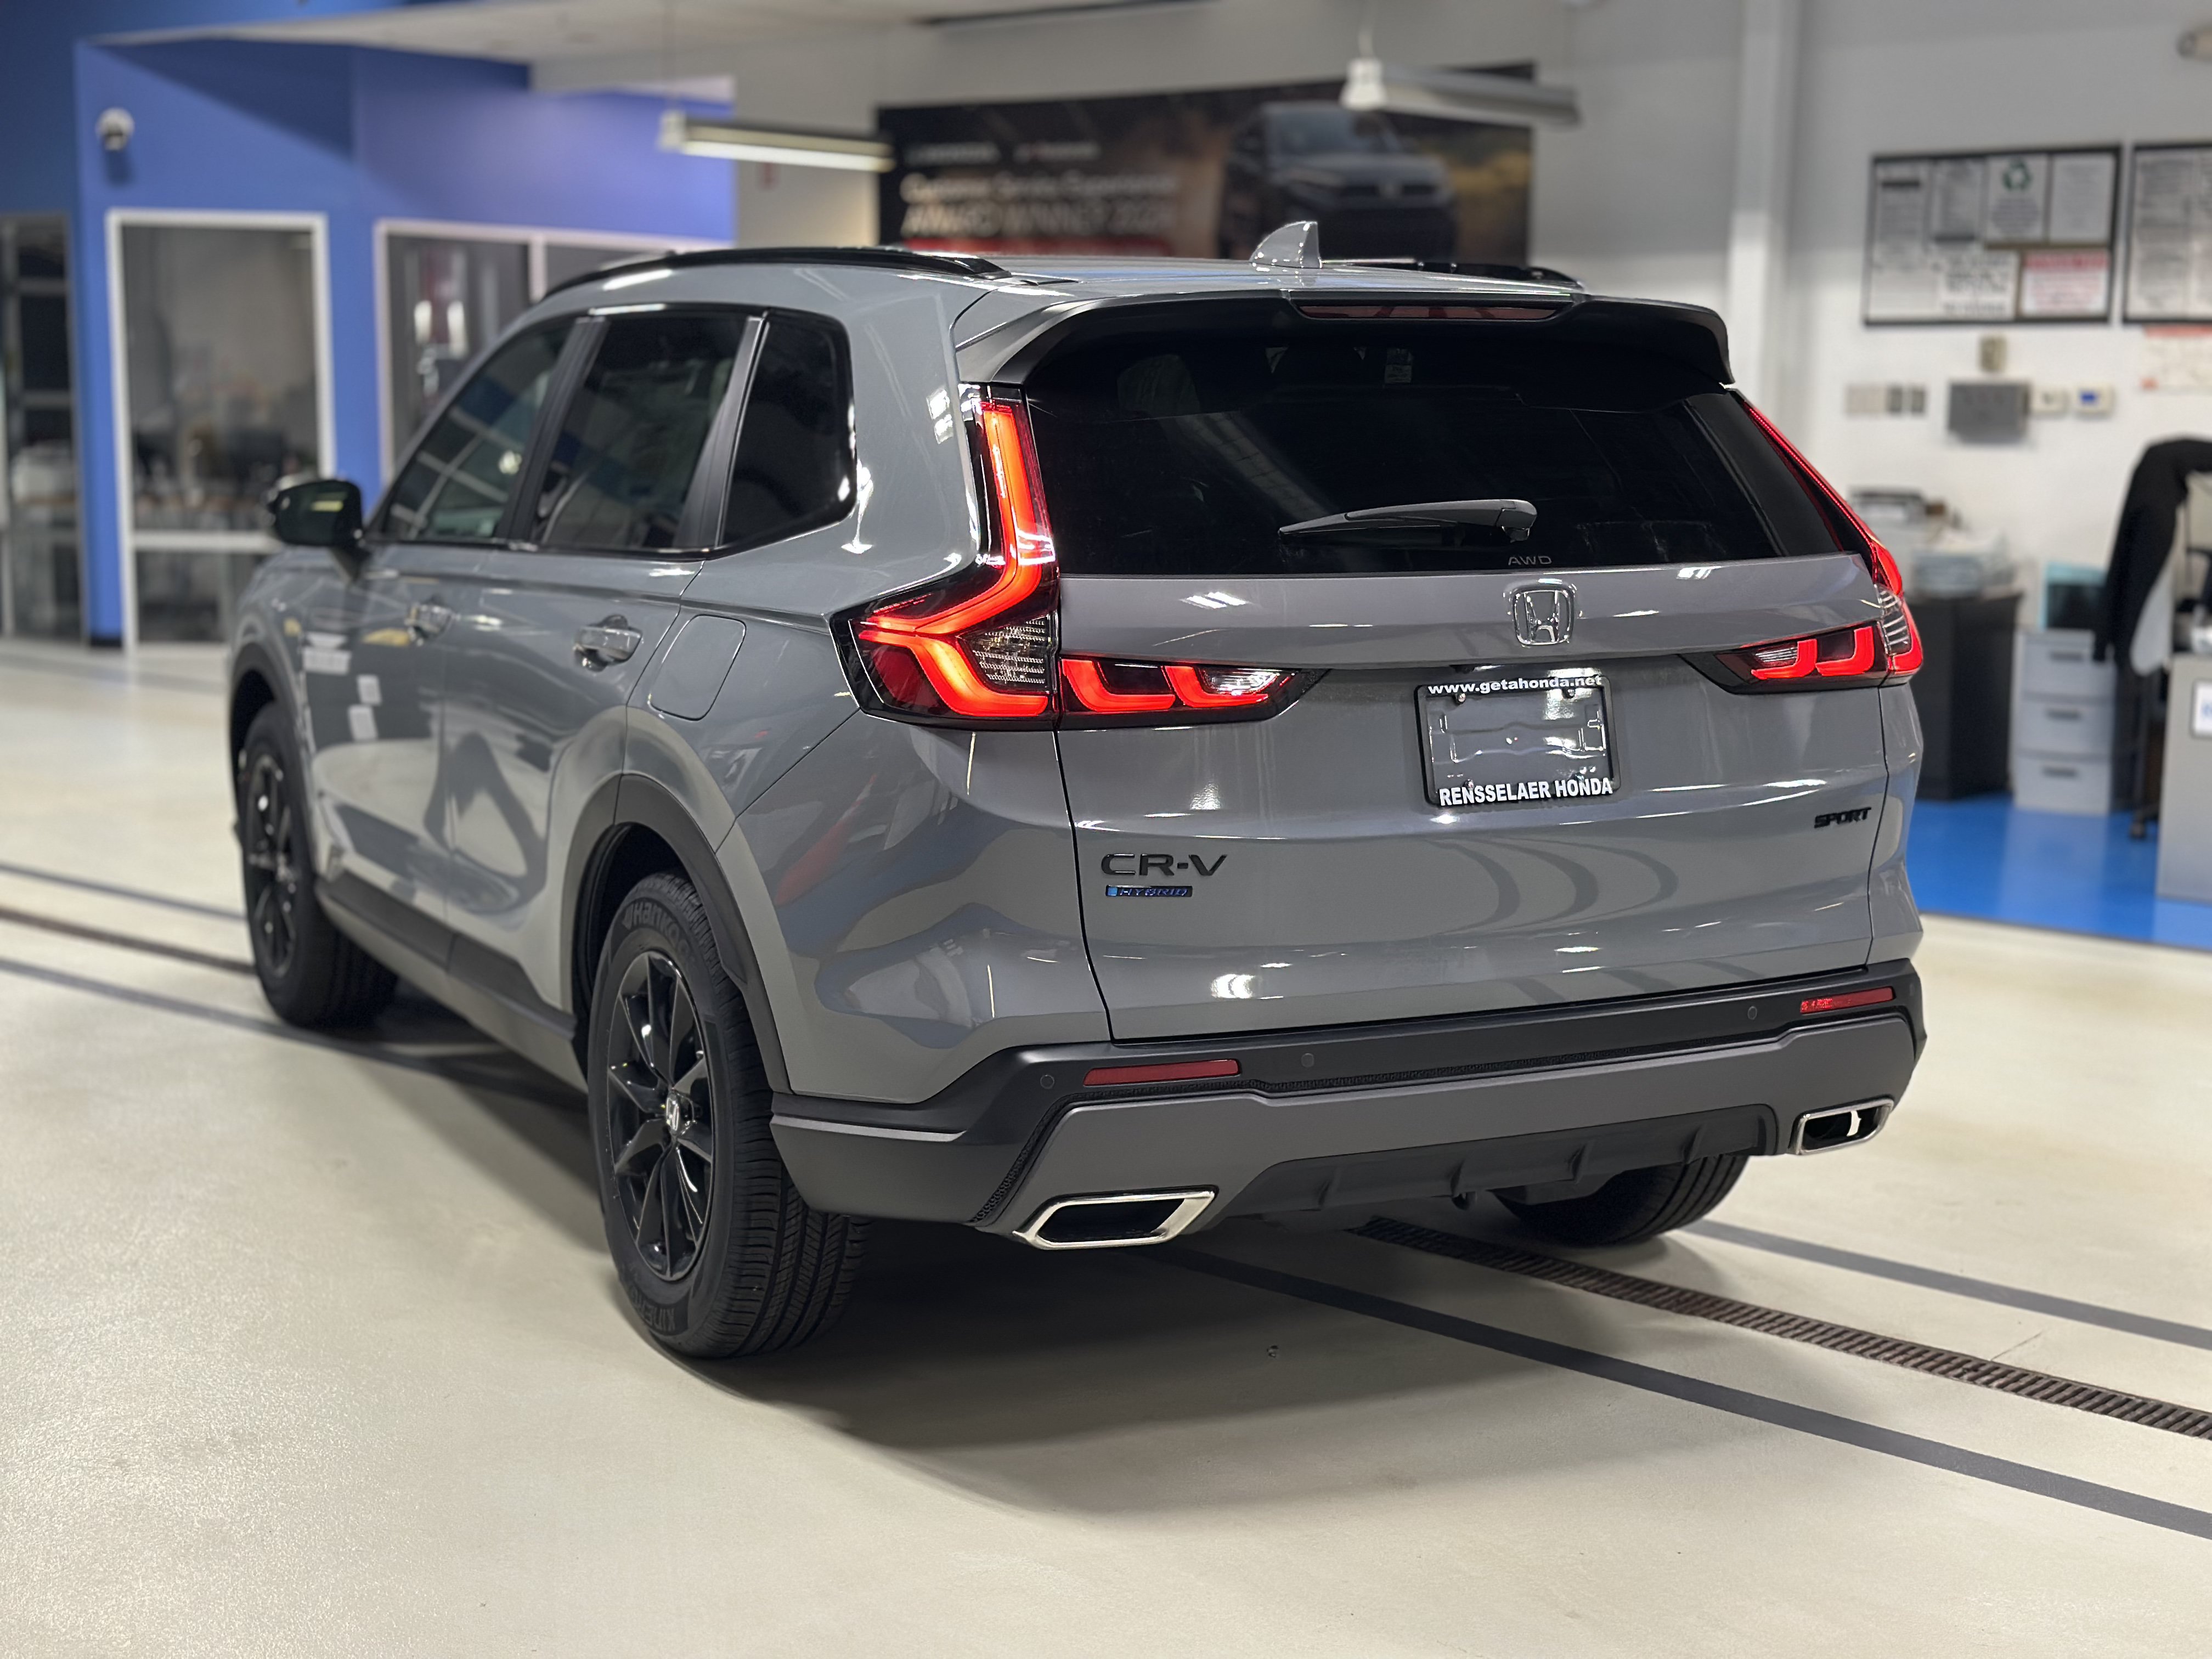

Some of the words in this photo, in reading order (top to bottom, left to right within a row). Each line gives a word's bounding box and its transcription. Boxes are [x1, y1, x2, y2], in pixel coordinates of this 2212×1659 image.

[1508, 555, 1552, 566] AWD
[1428, 675, 1602, 694] www.getahonda.net
[1439, 780, 1551, 806] RENSSELAER
[1554, 777, 1613, 798] HONDA
[1814, 806, 1872, 829] SPORT
[1101, 854, 1227, 876] CR-V
[1119, 887, 1189, 898] HYBRID
